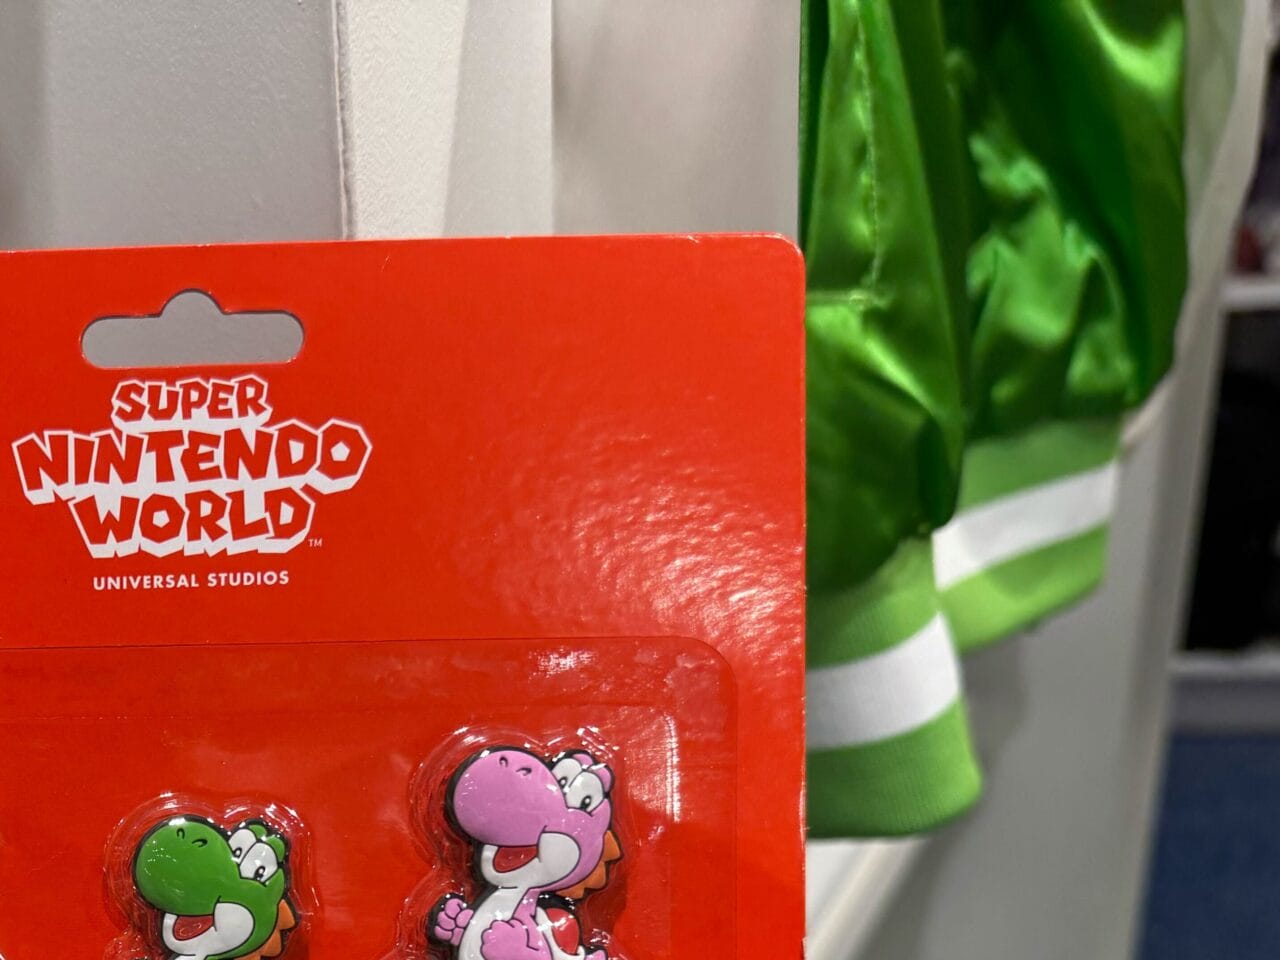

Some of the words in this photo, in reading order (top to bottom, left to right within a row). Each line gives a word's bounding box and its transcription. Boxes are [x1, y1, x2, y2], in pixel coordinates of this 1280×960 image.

[111, 374, 272, 425] SUPER
[12, 418, 373, 505] NINTENDO
[68, 483, 316, 558] WORLD
[93, 573, 200, 591] UNIVERSAL
[207, 570, 289, 587] STUDIOS
